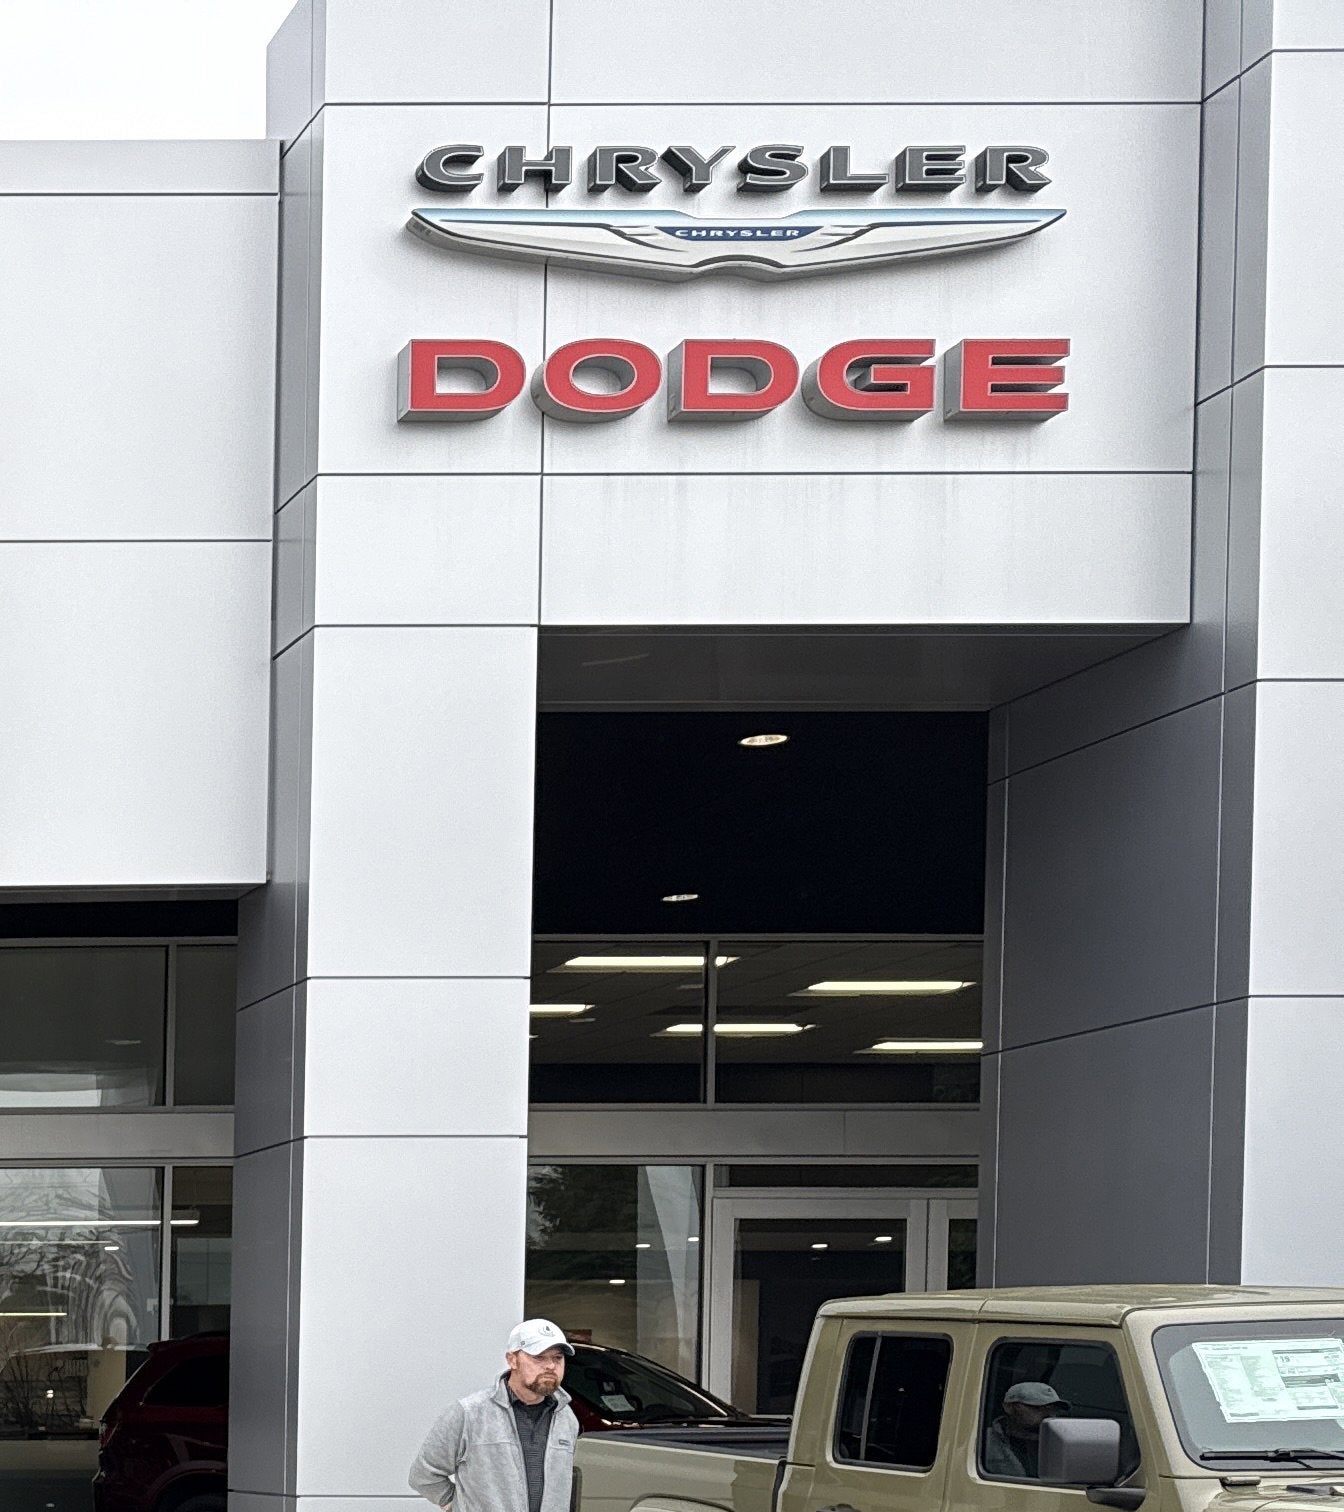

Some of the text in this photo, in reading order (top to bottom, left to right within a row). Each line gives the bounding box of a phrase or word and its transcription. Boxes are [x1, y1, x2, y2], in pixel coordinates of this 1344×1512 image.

[415, 144, 1052, 193] CHRYSLER
[675, 228, 800, 238] CHRYSLER
[397, 337, 1072, 422] DODGE
